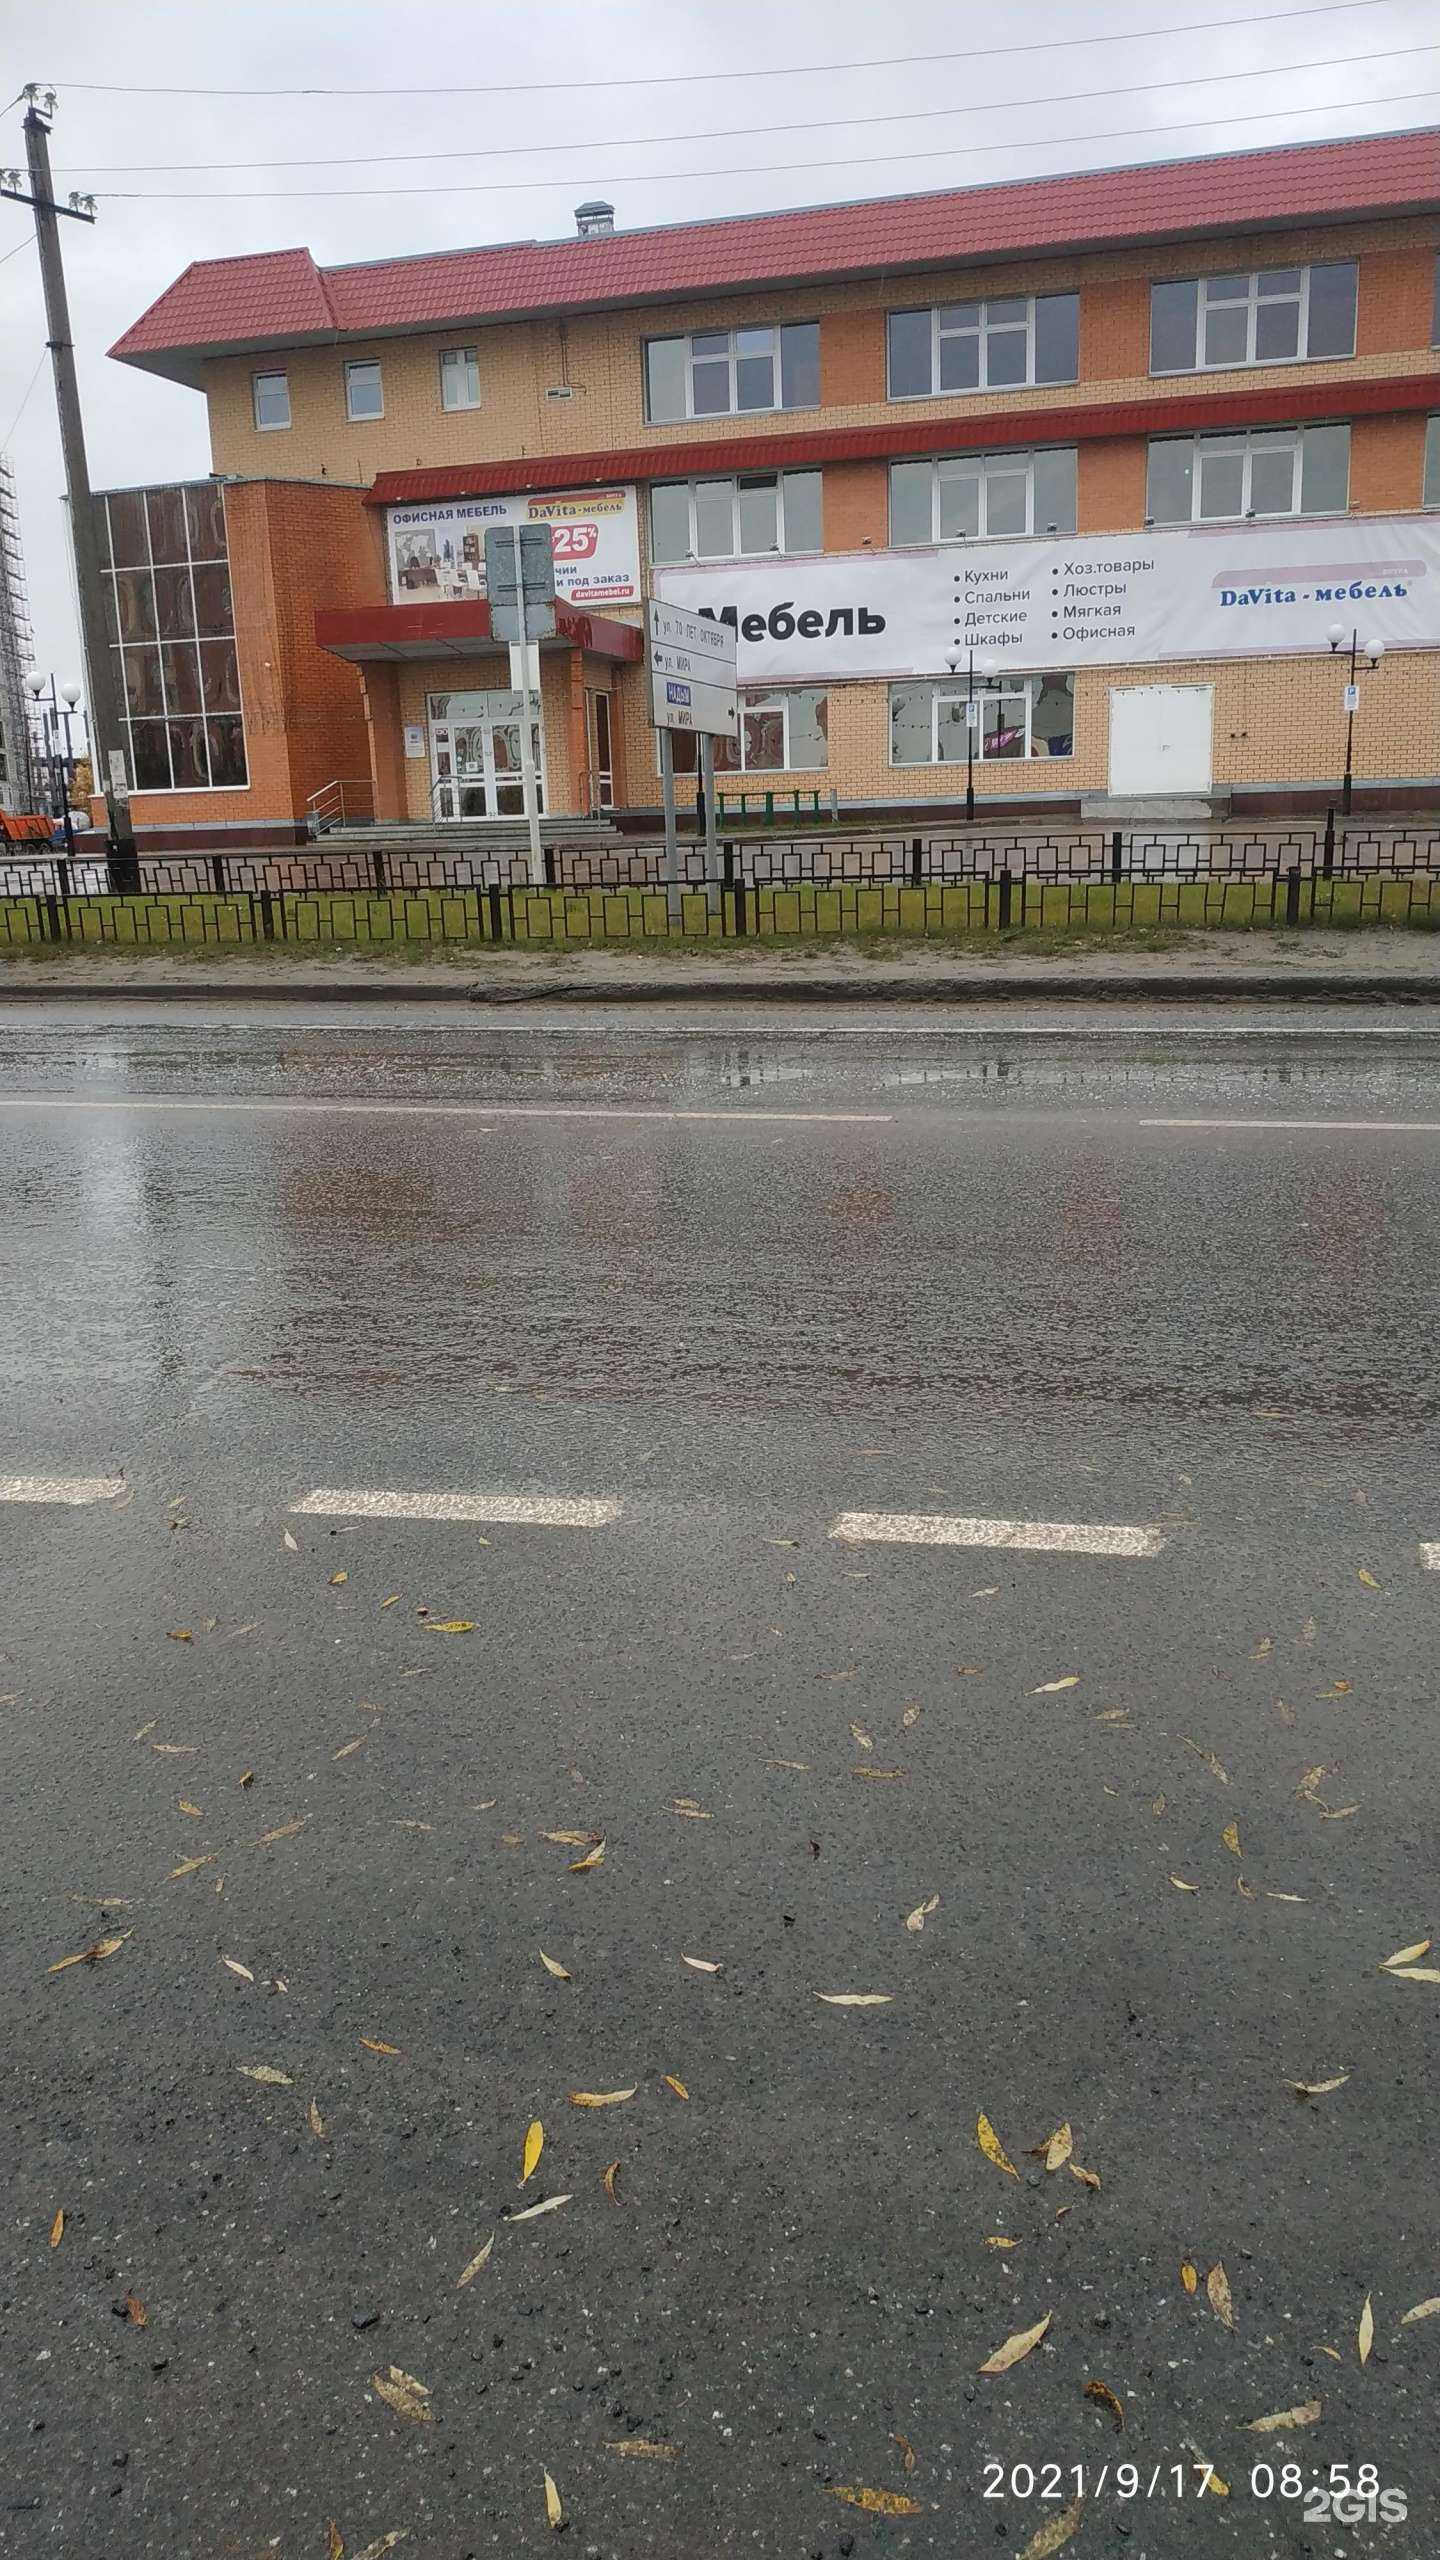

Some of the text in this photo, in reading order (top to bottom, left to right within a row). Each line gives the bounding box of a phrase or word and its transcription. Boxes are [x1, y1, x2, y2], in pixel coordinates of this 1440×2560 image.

[393, 505, 507, 524] ОФИСНАЯ МЕБЕЛЬ
[528, 505, 577, 520] DaVita
[1063, 558, 1155, 577] Хоз.товары
[567, 577, 590, 587] под
[592, 574, 630, 585] заказ
[964, 569, 1009, 586] Кухни
[964, 590, 1031, 605] Спальни
[1063, 583, 1127, 600] Люстры
[1220, 587, 1297, 607] DaVita
[1315, 580, 1408, 603] мебель
[964, 611, 1028, 628] Детские
[1063, 604, 1122, 619] Мягкая
[964, 632, 1024, 648] Шкафы
[1062, 624, 1136, 642] Офисная
